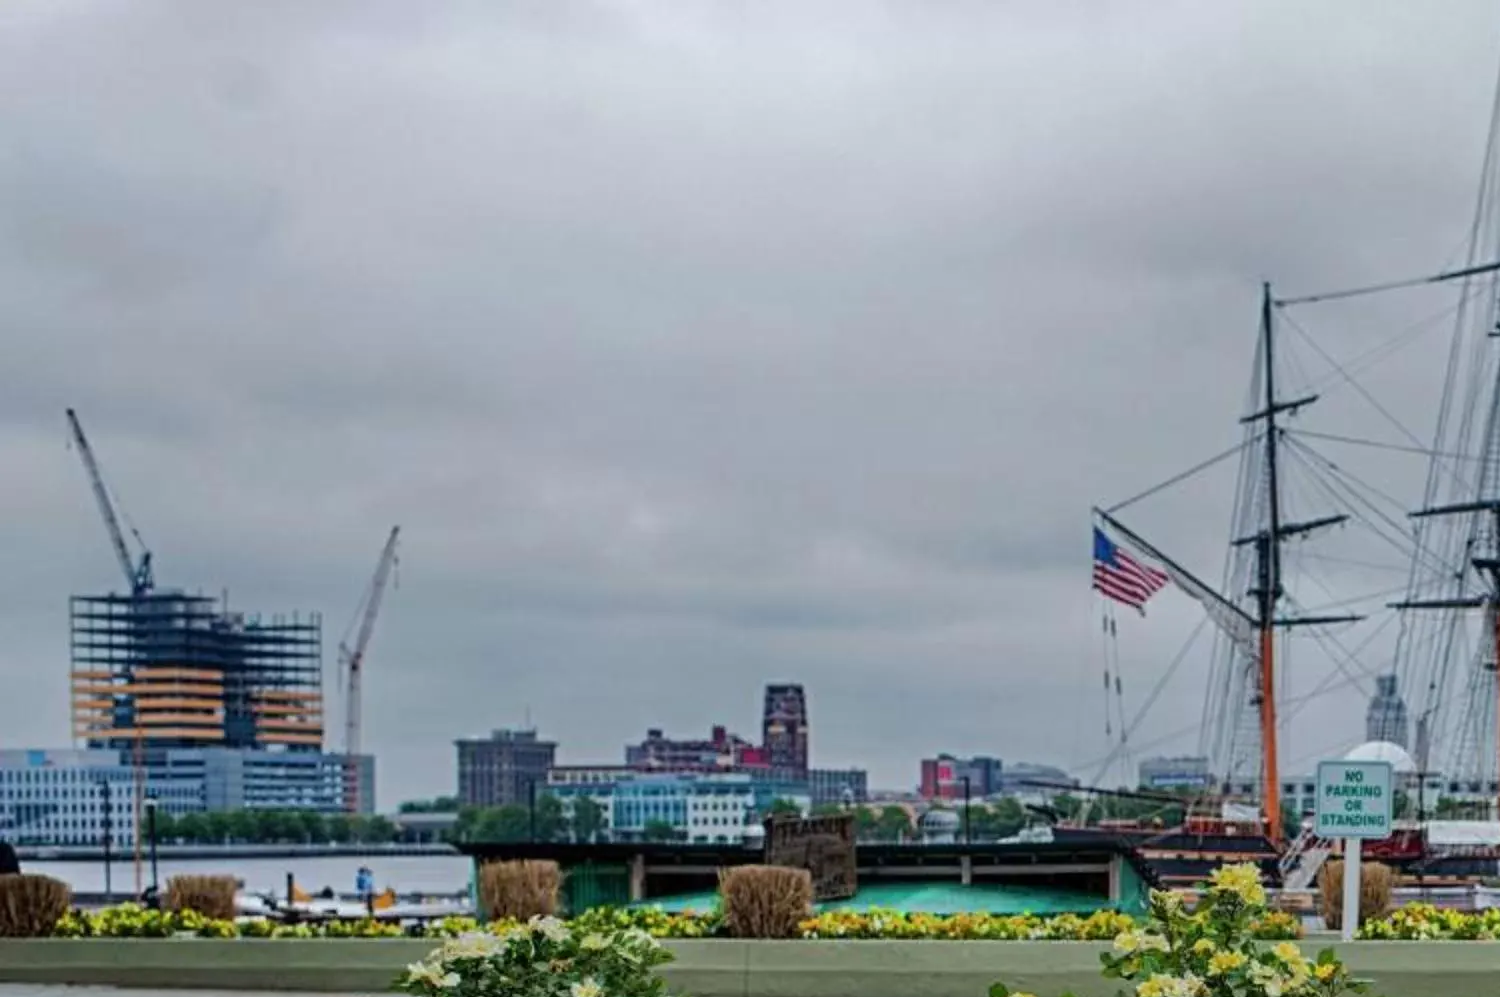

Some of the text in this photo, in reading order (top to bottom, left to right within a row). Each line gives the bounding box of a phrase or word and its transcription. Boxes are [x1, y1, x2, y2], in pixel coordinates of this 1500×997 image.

[1345, 770, 1363, 781] NO
[1326, 785, 1382, 797] PARKING
[1344, 800, 1362, 811] OR
[1321, 814, 1385, 826] STANDING
